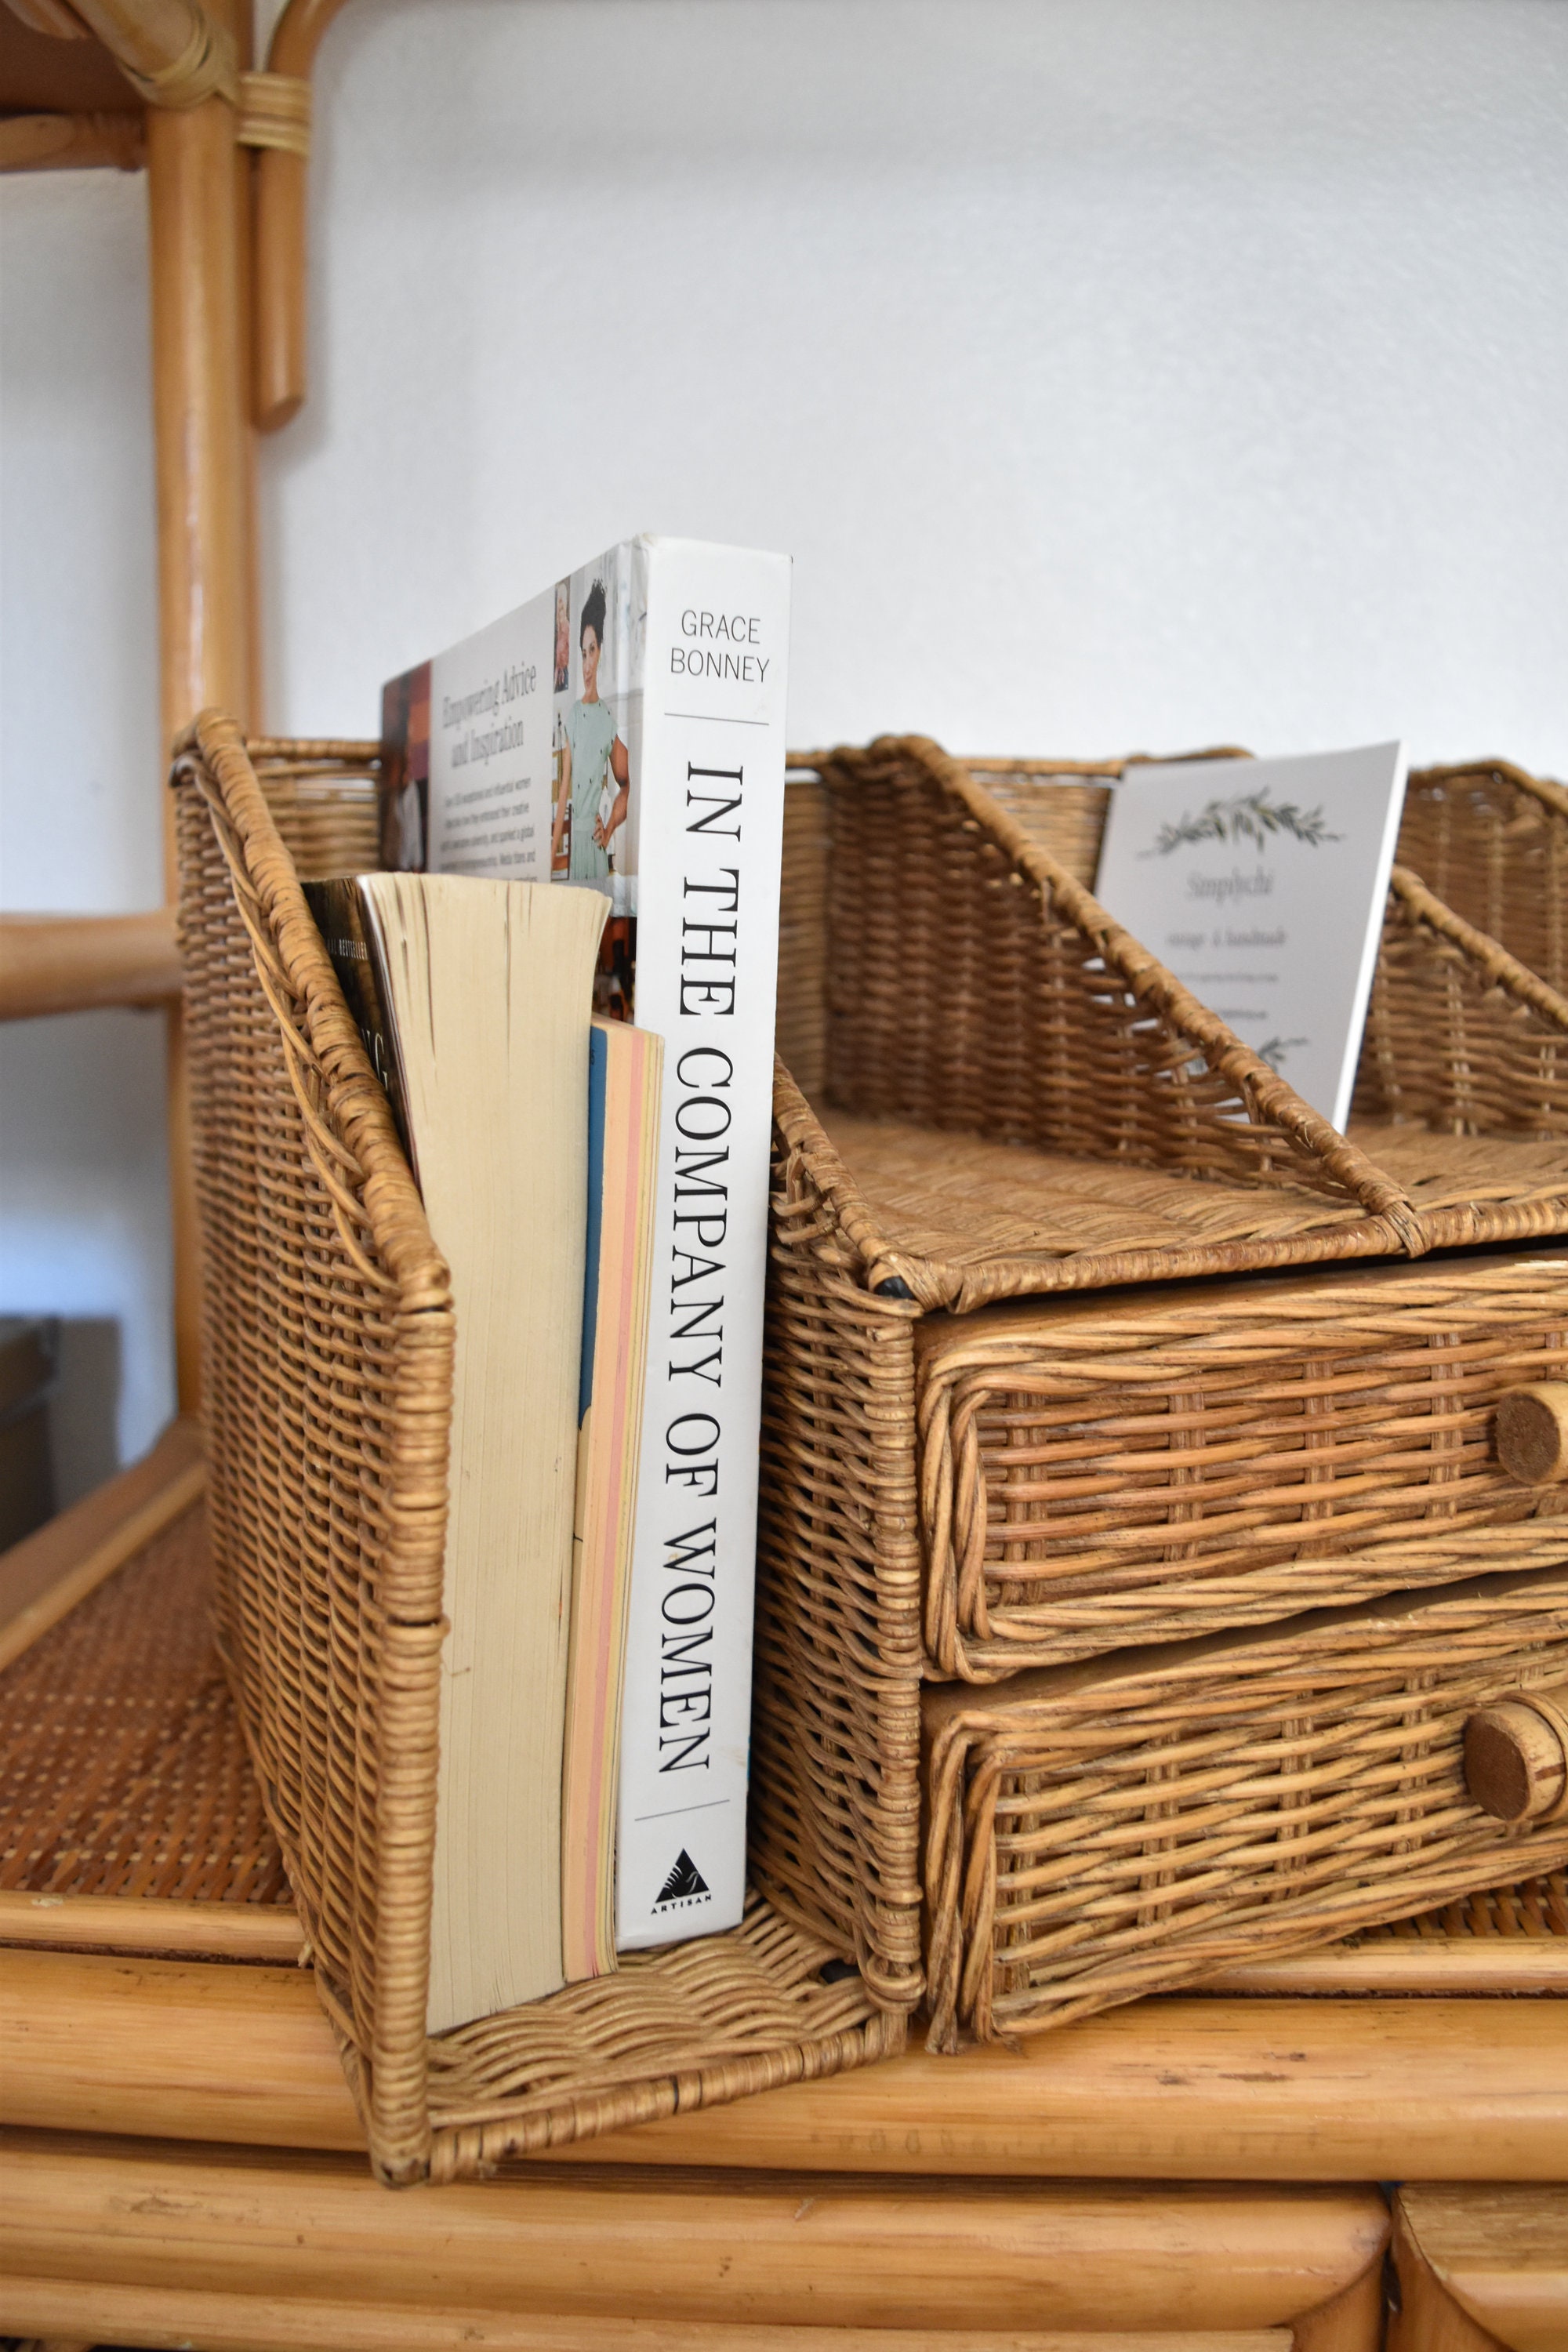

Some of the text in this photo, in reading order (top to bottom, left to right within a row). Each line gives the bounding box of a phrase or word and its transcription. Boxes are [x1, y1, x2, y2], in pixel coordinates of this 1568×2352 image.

[681, 609, 761, 644] GRACE
[501, 660, 537, 705] Advice
[670, 648, 771, 683] BONNEY
[470, 714, 524, 765] Inspiration
[659, 761, 743, 1773] IN THE COMPANY OF WOMEN
[650, 1893, 713, 1915] ARTISAN
